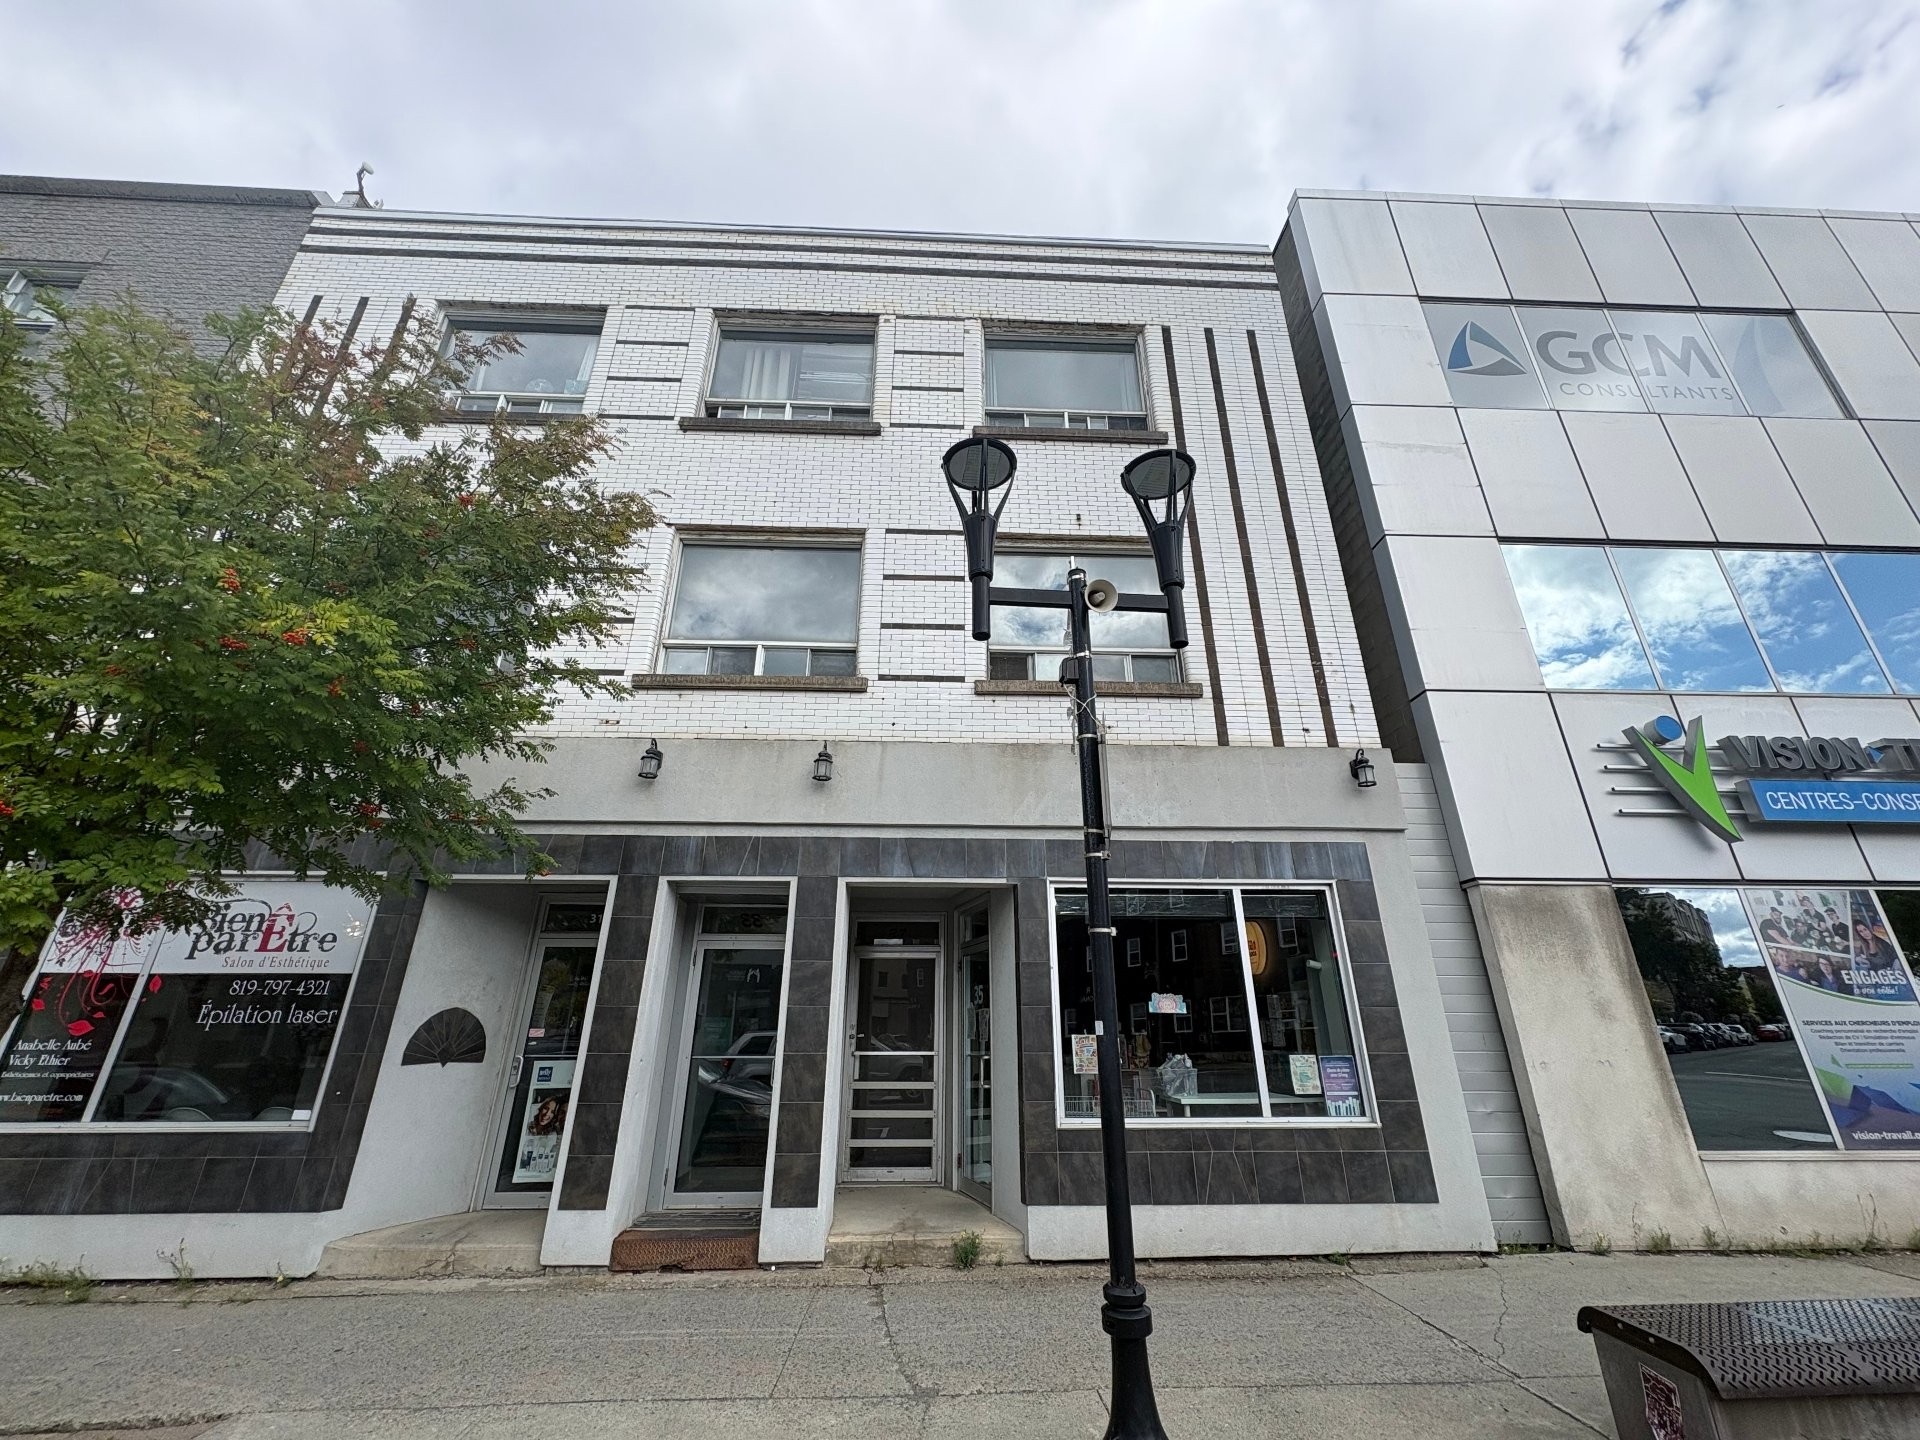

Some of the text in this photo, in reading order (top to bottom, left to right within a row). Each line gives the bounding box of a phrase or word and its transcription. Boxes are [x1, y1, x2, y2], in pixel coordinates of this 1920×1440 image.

[1536, 330, 1722, 379] GCM
[1559, 382, 1735, 401] CONSULTANTS
[1717, 735, 1872, 770] VISION
[222, 955, 331, 970] Salon d'Esthétique
[1840, 967, 1907, 985] ENGAGÉS
[229, 979, 331, 996] 819-797-4321
[973, 984, 984, 1005] 35
[196, 1000, 338, 1032] Épilation laser
[13, 1038, 61, 1051] Anabelle
[9, 1054, 37, 1070] Vicky
